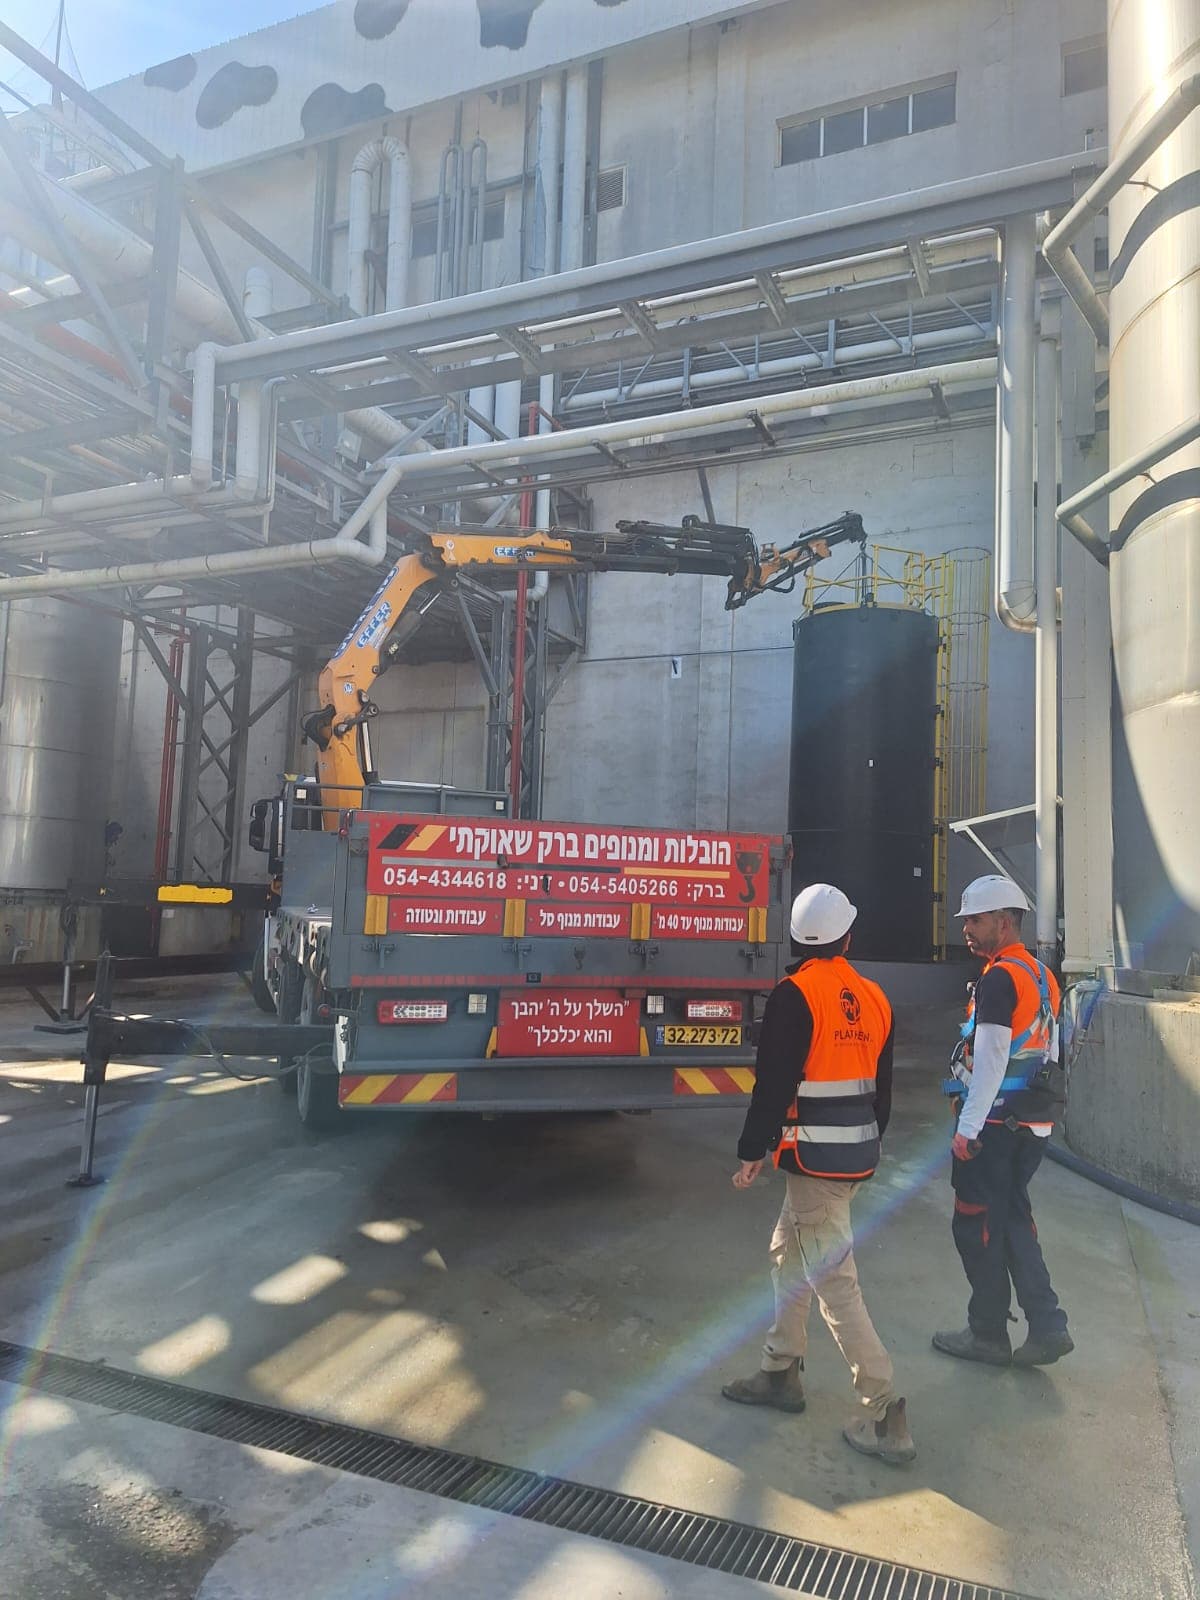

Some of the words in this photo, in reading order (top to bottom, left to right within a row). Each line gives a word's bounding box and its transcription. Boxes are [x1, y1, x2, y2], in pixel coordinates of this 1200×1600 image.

[359, 602, 390, 645] EFFER
[449, 826, 533, 860] שאוקתי
[538, 831, 579, 863] ברק
[584, 833, 659, 862] ומנופים
[664, 835, 731, 865] הובלות
[383, 868, 507, 889] 054-4344618
[569, 876, 678, 897] 054-5405266
[687, 882, 726, 901] ברק:
[445, 909, 487, 926] עבודות
[539, 909, 555, 927] סל
[557, 912, 582, 930] מנוף
[583, 913, 621, 929] עבודות
[667, 914, 679, 930] 40
[680, 915, 693, 930] עד
[694, 915, 713, 933] מנוף
[714, 917, 744, 932] עבודות
[511, 1001, 543, 1019] יהבך
[563, 998, 582, 1017] על
[583, 1029, 612, 1043] והוא
